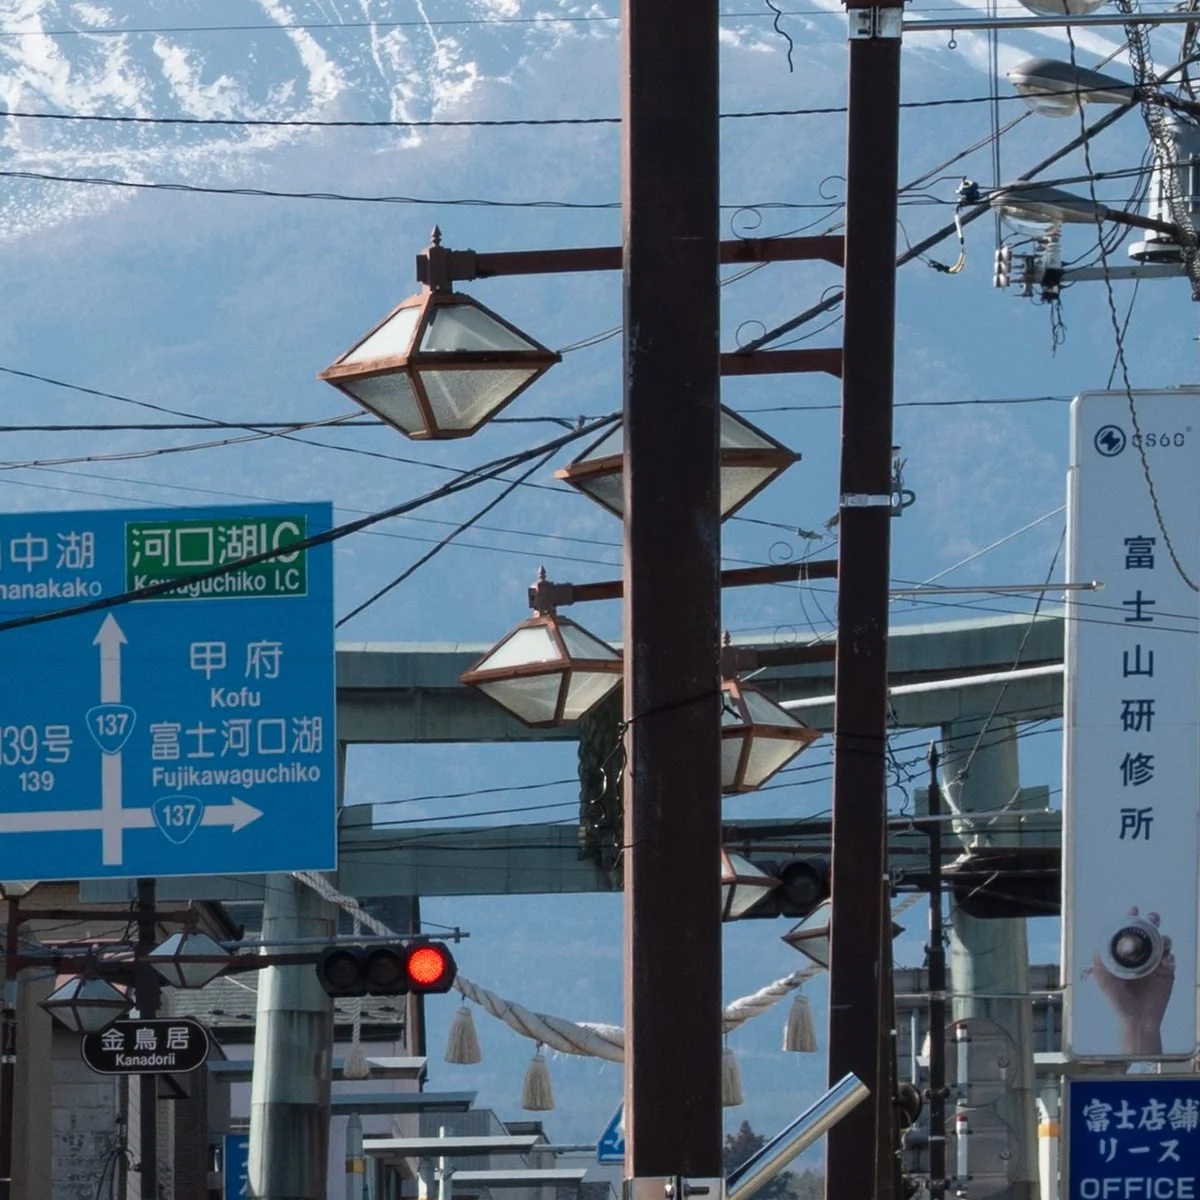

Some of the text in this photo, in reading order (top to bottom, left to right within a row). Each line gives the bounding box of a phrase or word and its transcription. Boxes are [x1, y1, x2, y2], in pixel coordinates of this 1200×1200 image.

[190, 640, 283, 680] 甲府
[210, 687, 261, 709] Kofu
[1119, 535, 1156, 840] 富士山研修所
[96, 717, 129, 737] 137
[149, 716, 323, 761] 富士河口湖
[19, 770, 55, 792] 139
[152, 764, 321, 792] Fujikawaguchiko
[163, 808, 196, 828] 137
[101, 1027, 190, 1051] 金鳥居
[115, 1053, 176, 1067] Kanadorii
[1082, 1098, 1199, 1133] 富士店舗
[1099, 1138, 1181, 1163] リース
[1080, 1177, 1196, 1200] OFFICE
